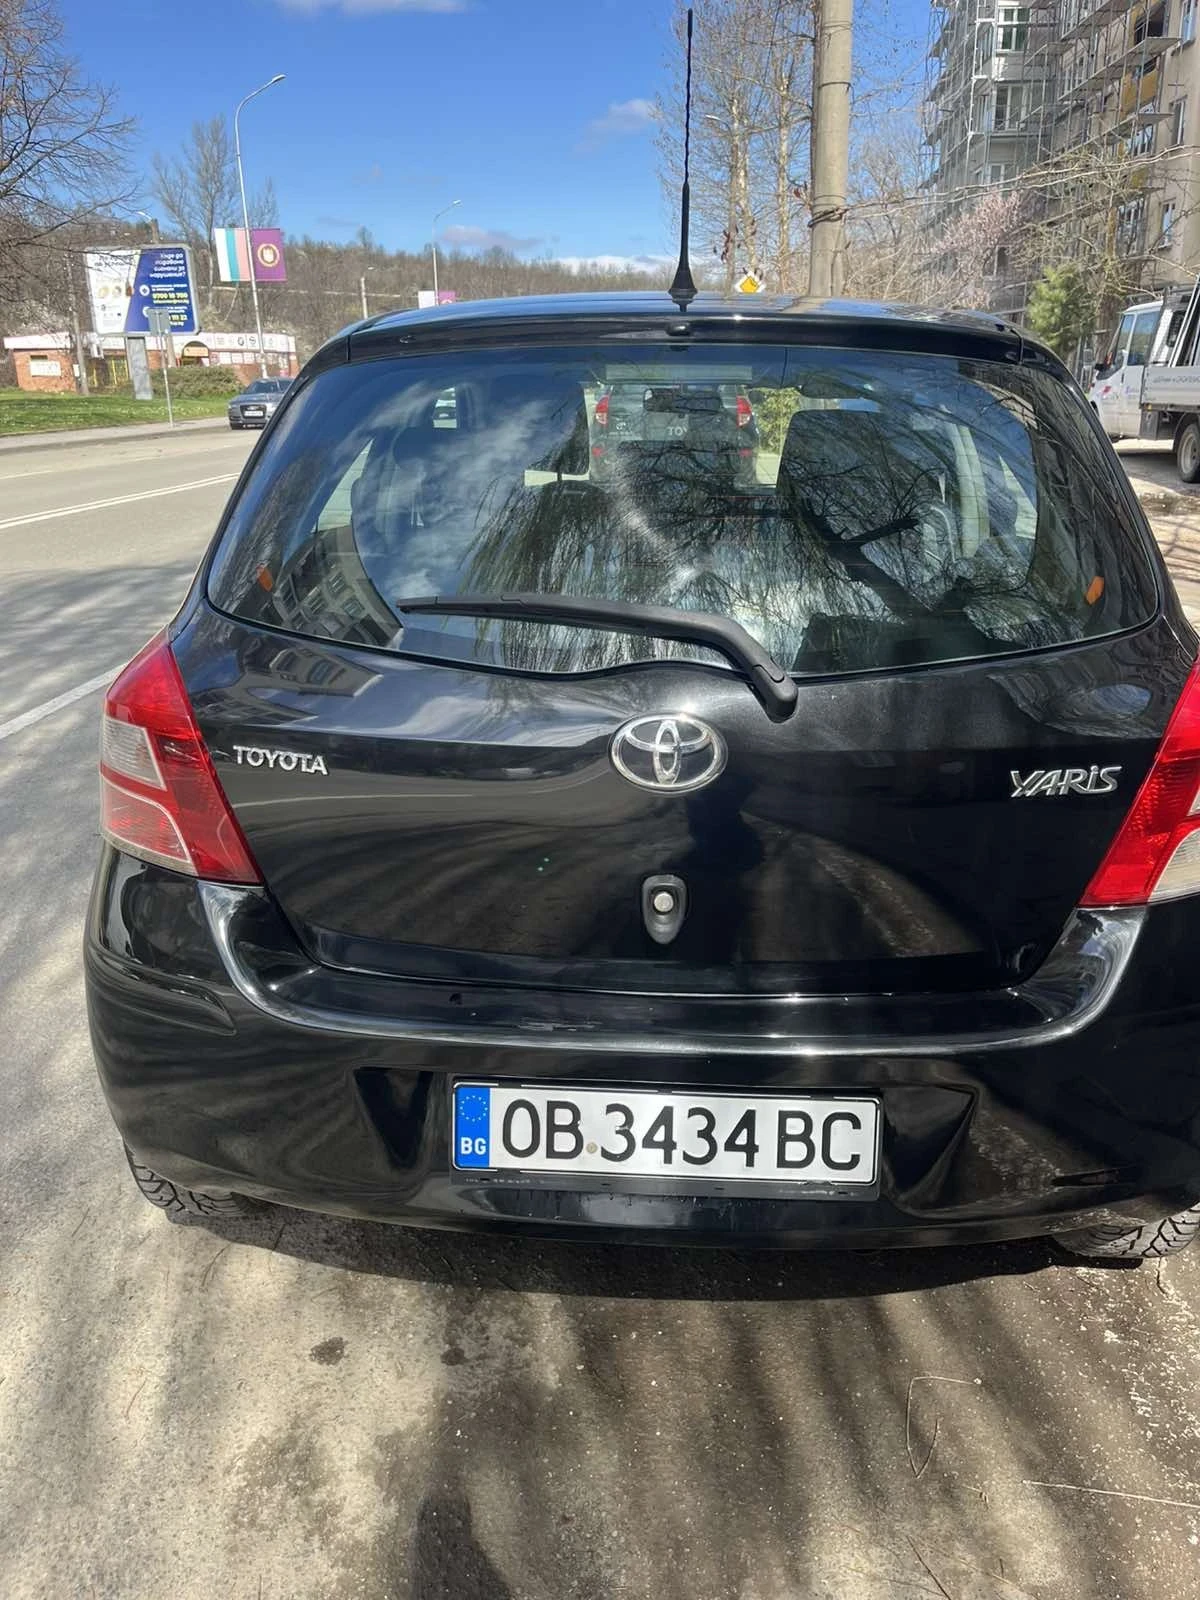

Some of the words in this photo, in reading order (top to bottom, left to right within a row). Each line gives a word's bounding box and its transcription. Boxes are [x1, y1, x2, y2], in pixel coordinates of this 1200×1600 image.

[233, 744, 328, 776] TOYOTA
[460, 1136, 487, 1156] BG
[502, 1098, 585, 1160] OB
[600, 1102, 760, 1168] 3434
[776, 1109, 862, 1171] BC
